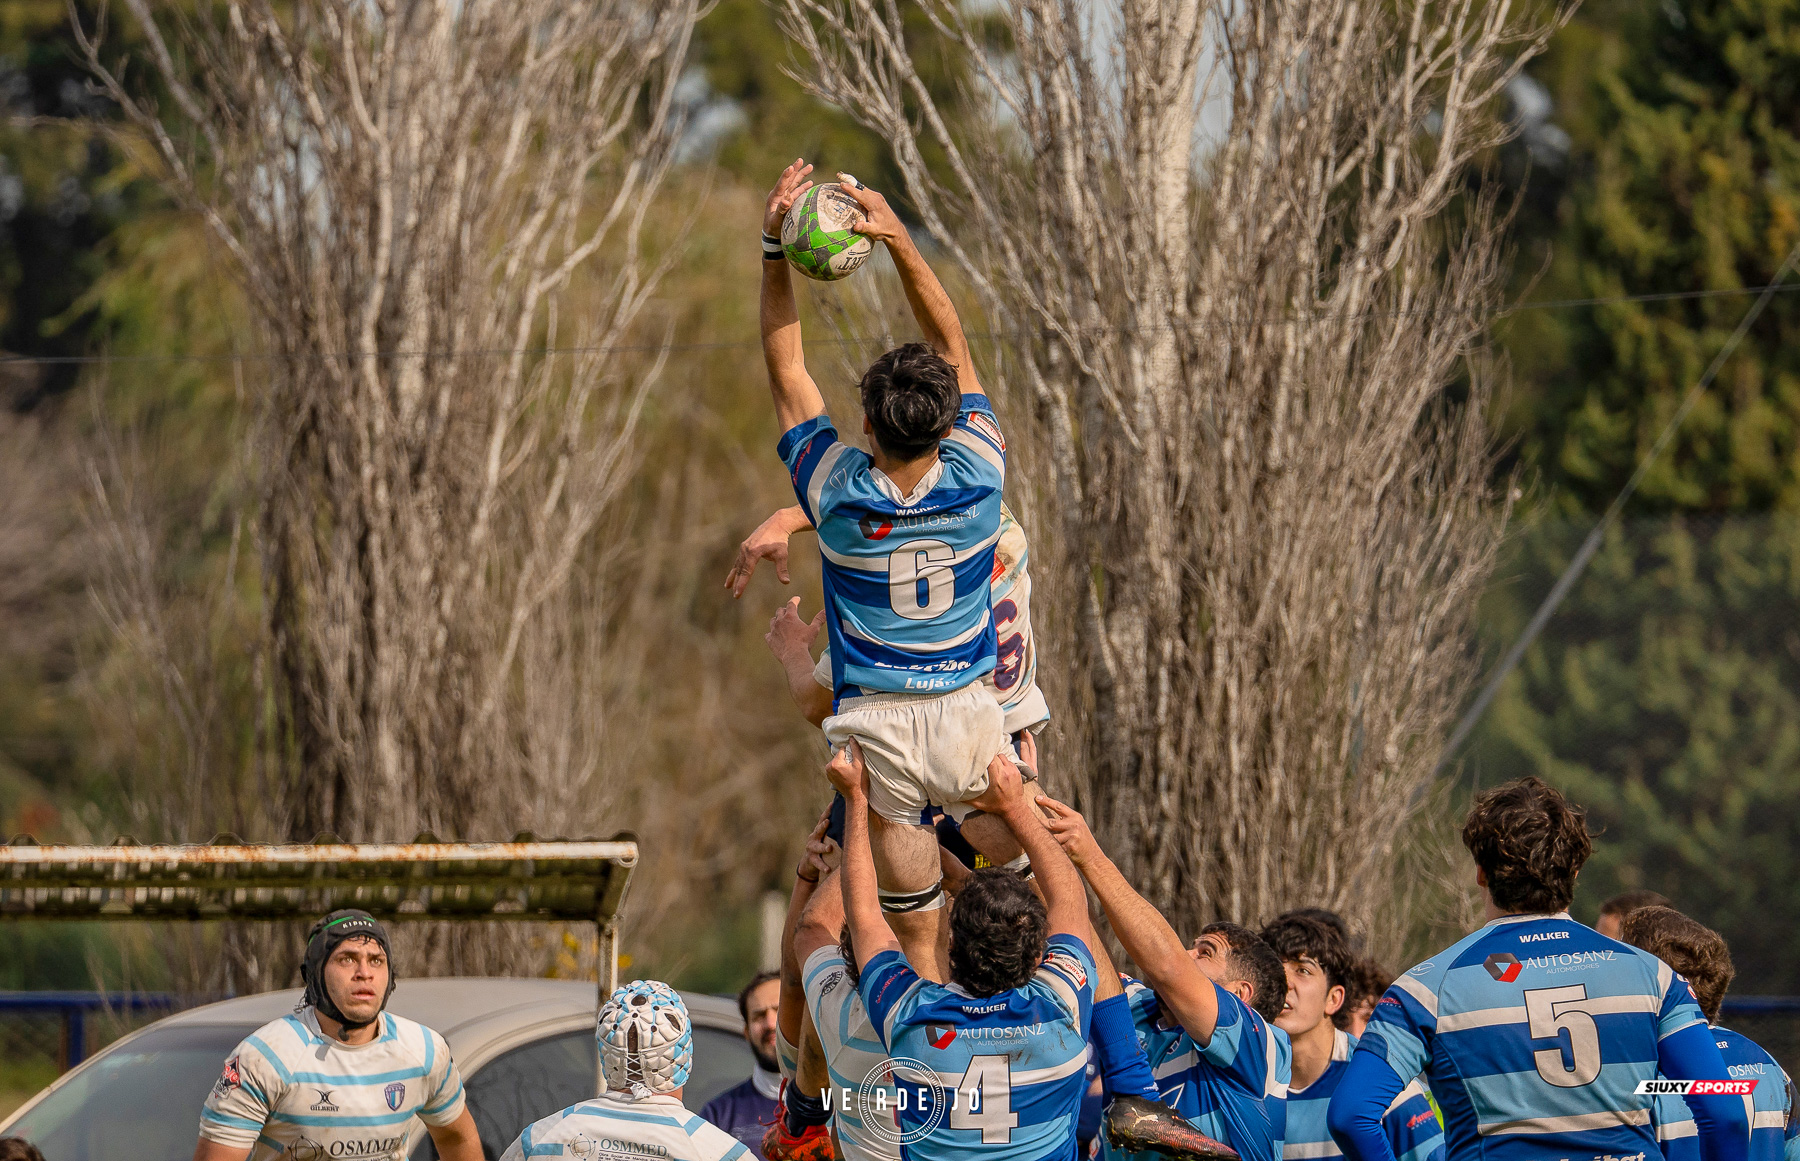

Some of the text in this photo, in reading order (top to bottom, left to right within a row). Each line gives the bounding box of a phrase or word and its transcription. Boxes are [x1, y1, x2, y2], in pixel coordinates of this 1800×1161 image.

[896, 504, 980, 530] AUTOSANZ
[888, 539, 956, 620] 6
[1519, 931, 1570, 943] WALKER
[1526, 949, 1617, 970] AUTOSANZ
[1546, 962, 1600, 975] AUTOMOTORES
[962, 1003, 1007, 1014] WALKER
[960, 1022, 1046, 1039] AUTOSANZ
[1523, 983, 1602, 1088] 5
[977, 1038, 1029, 1046] AUTOMOTORES
[1727, 1062, 1766, 1077] OSANZ
[950, 1054, 1019, 1144] 4
[600, 1138, 667, 1157] OSMMED
